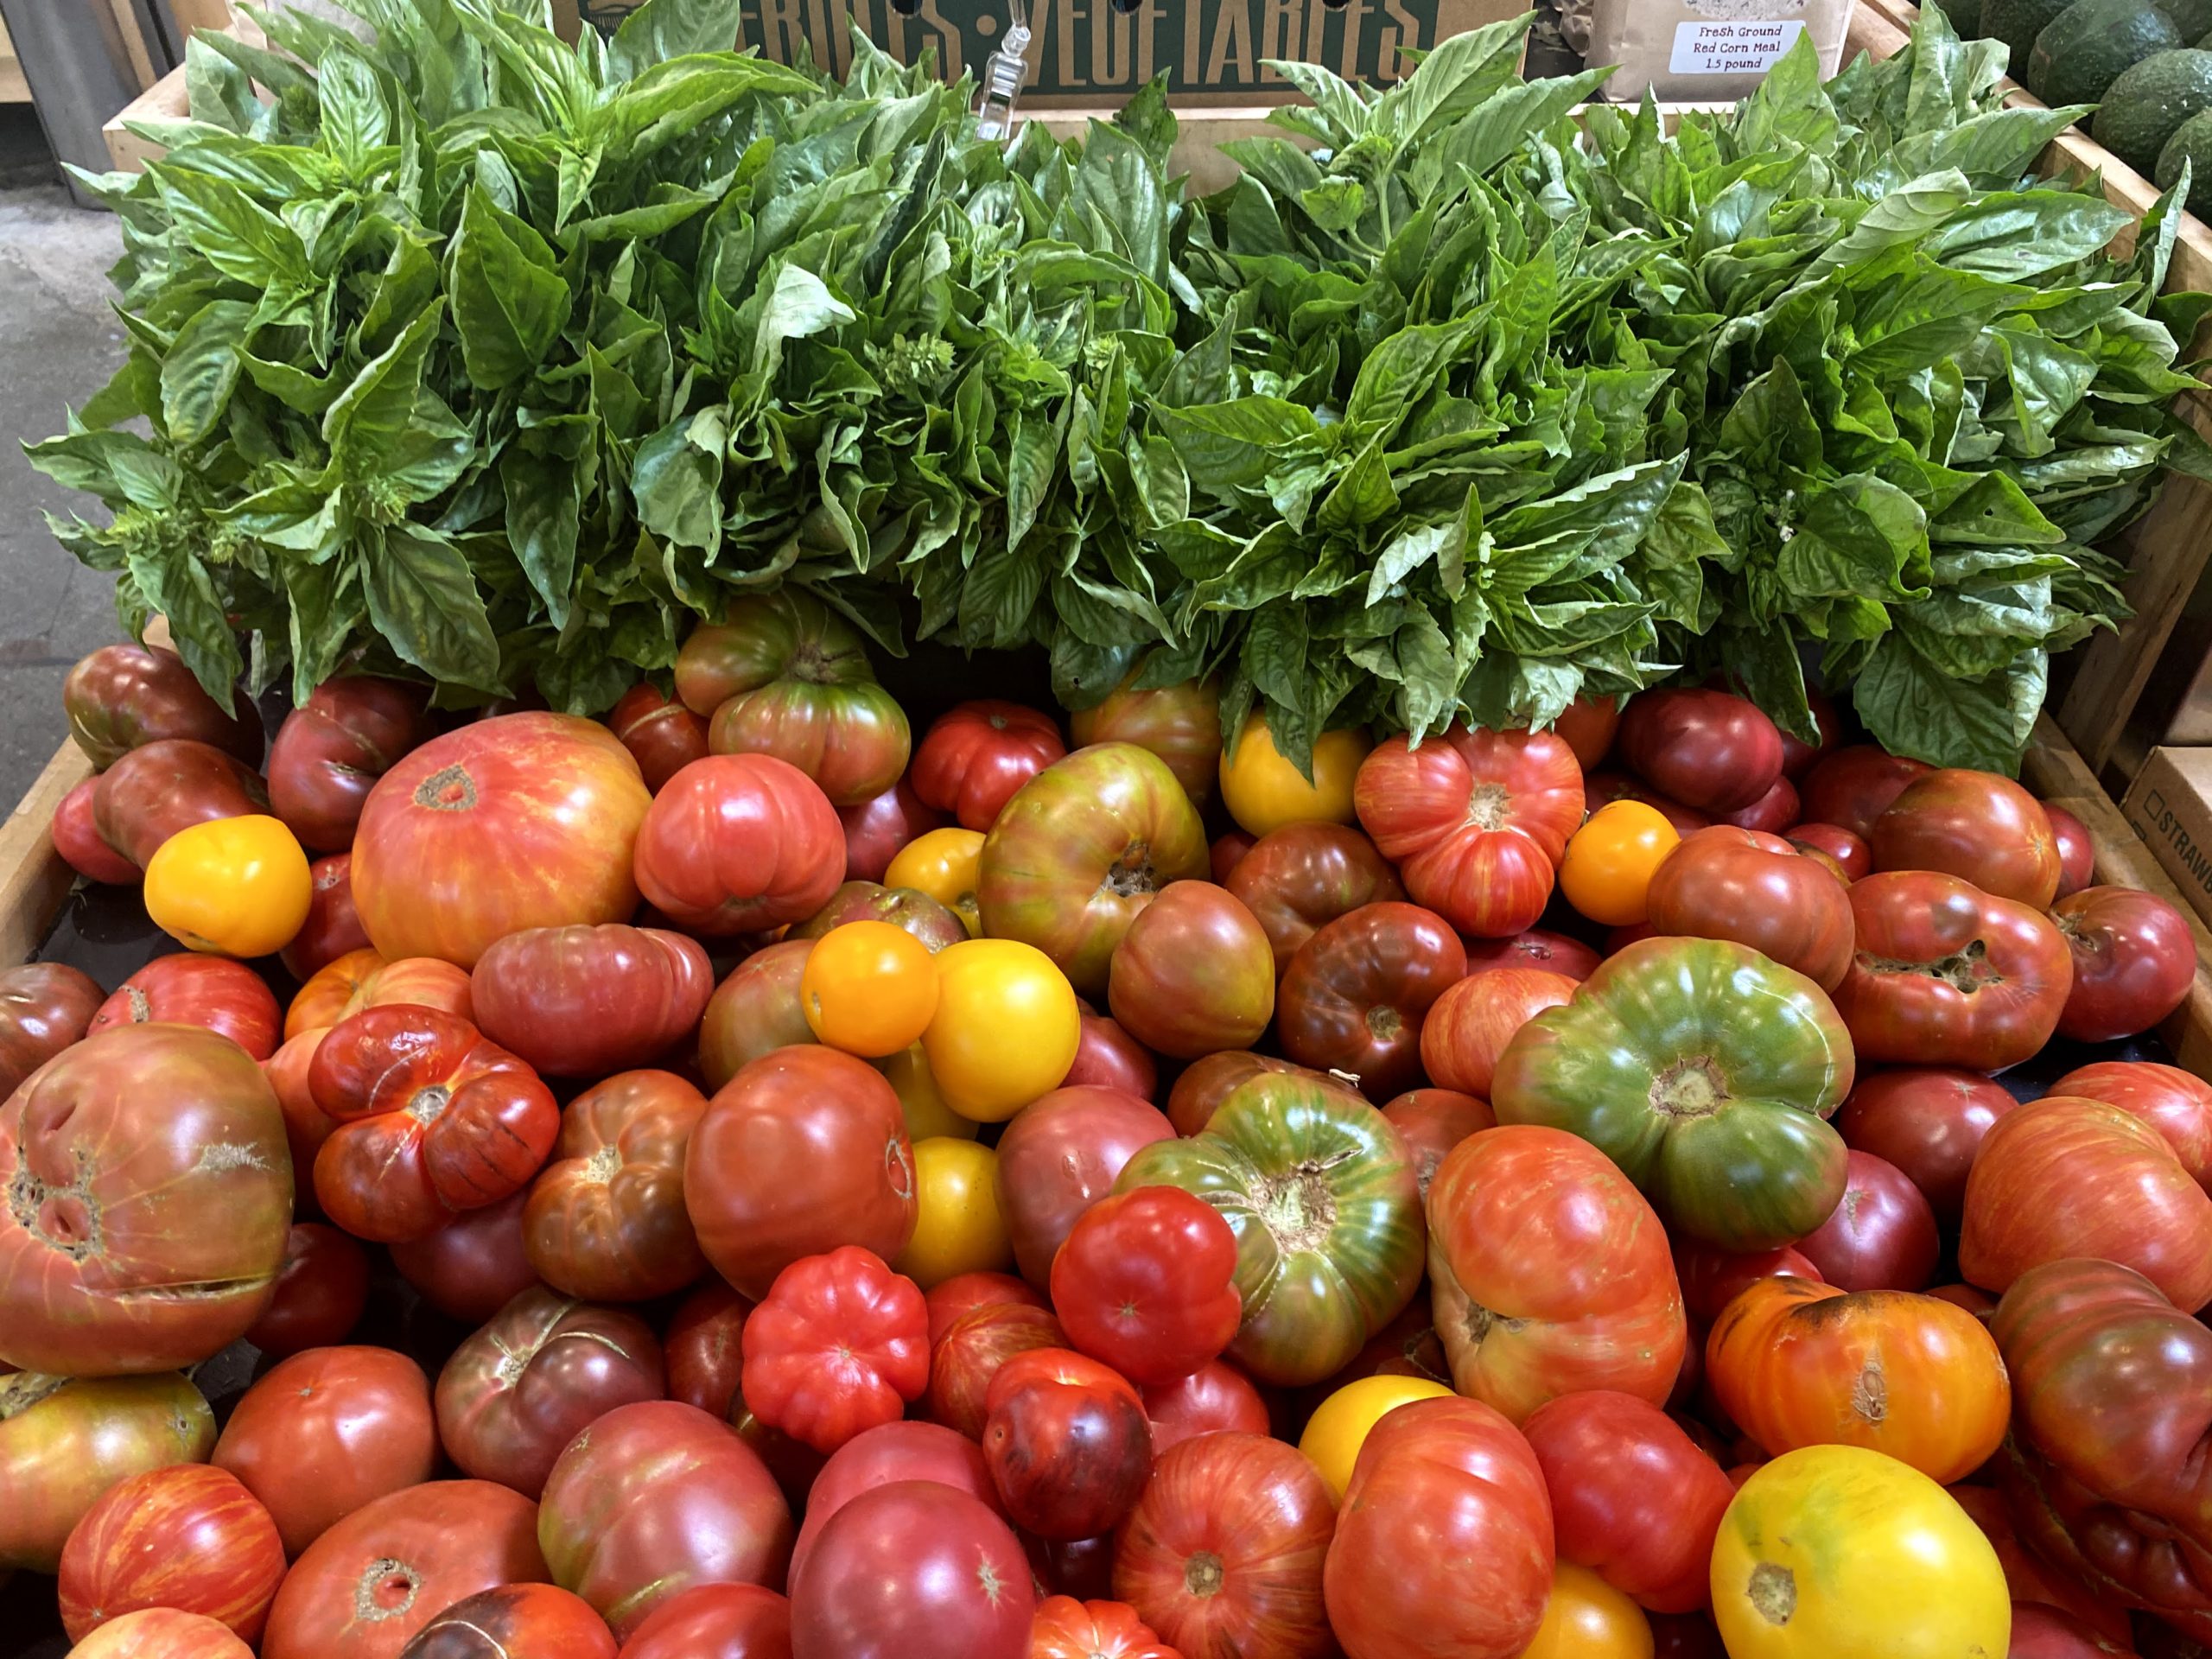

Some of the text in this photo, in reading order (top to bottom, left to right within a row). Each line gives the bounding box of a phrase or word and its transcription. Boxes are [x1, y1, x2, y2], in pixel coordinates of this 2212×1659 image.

[1738, 24, 1783, 37] Ground
[734, 0, 963, 88] RUTS
[1694, 41, 1781, 53] Red Corn Meal
[1706, 57, 1763, 72] 1.5 pound
